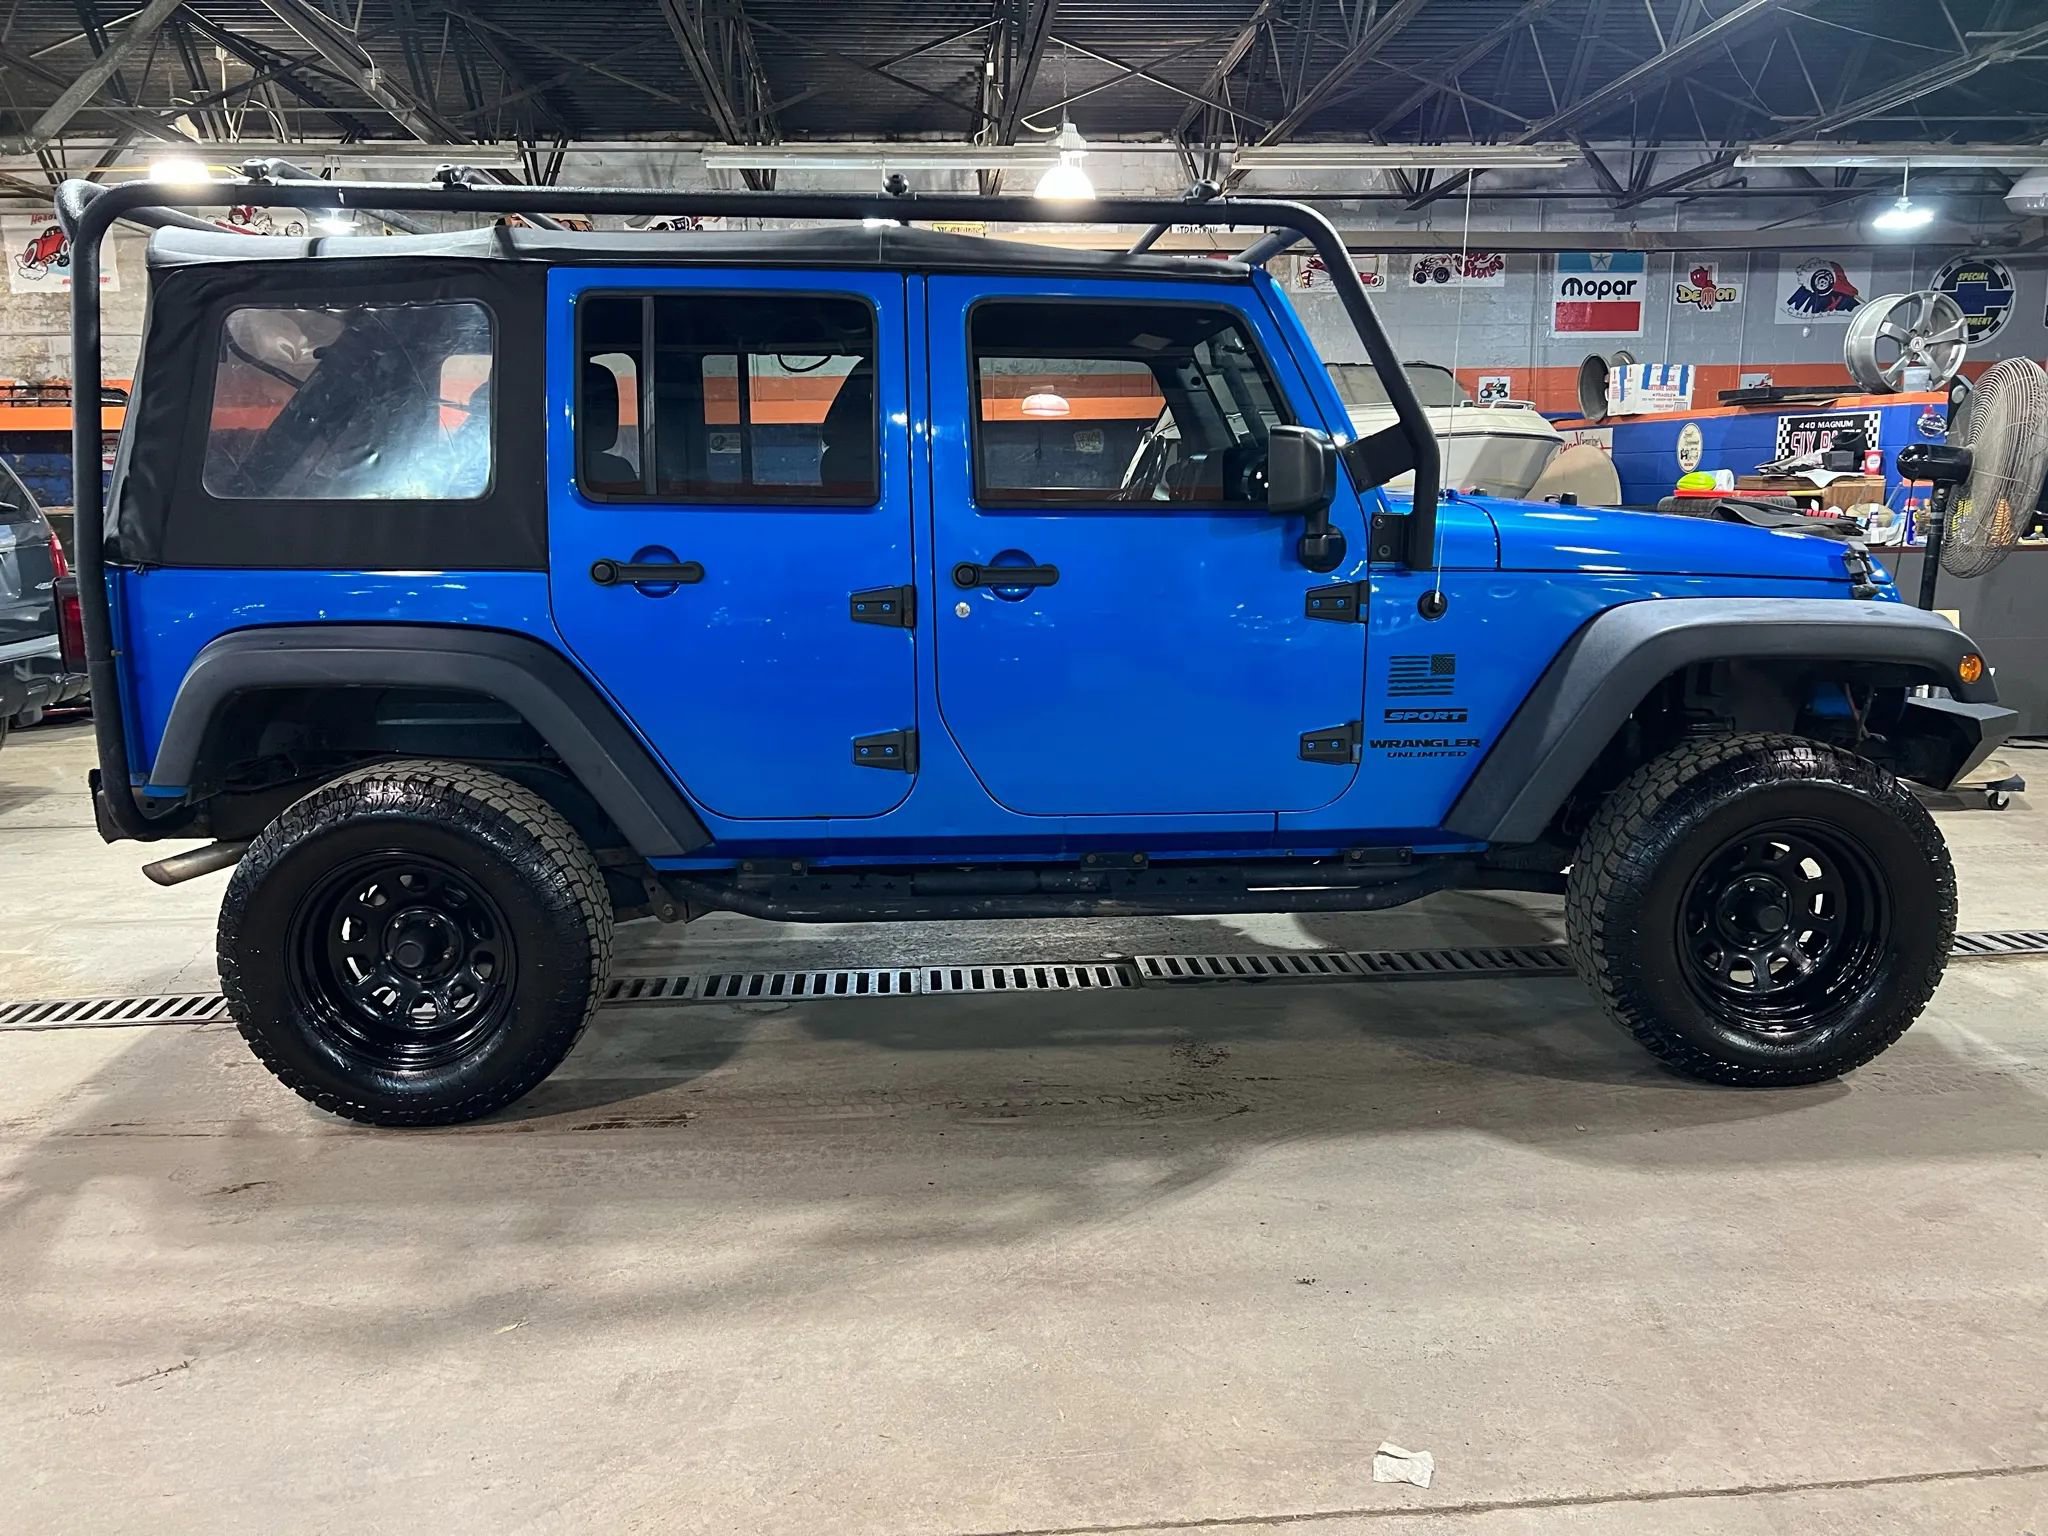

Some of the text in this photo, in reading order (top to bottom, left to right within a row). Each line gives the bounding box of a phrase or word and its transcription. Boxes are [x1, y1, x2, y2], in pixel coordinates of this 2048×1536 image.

[1957, 272, 1989, 281] SPECIAL
[1798, 420, 1854, 429] 440 MAGNUM
[1791, 430, 1817, 457] SIX
[1389, 711, 1463, 721] SPORT
[1370, 738, 1480, 749] WRANGLER
[1387, 751, 1467, 759] UNLIMITED
